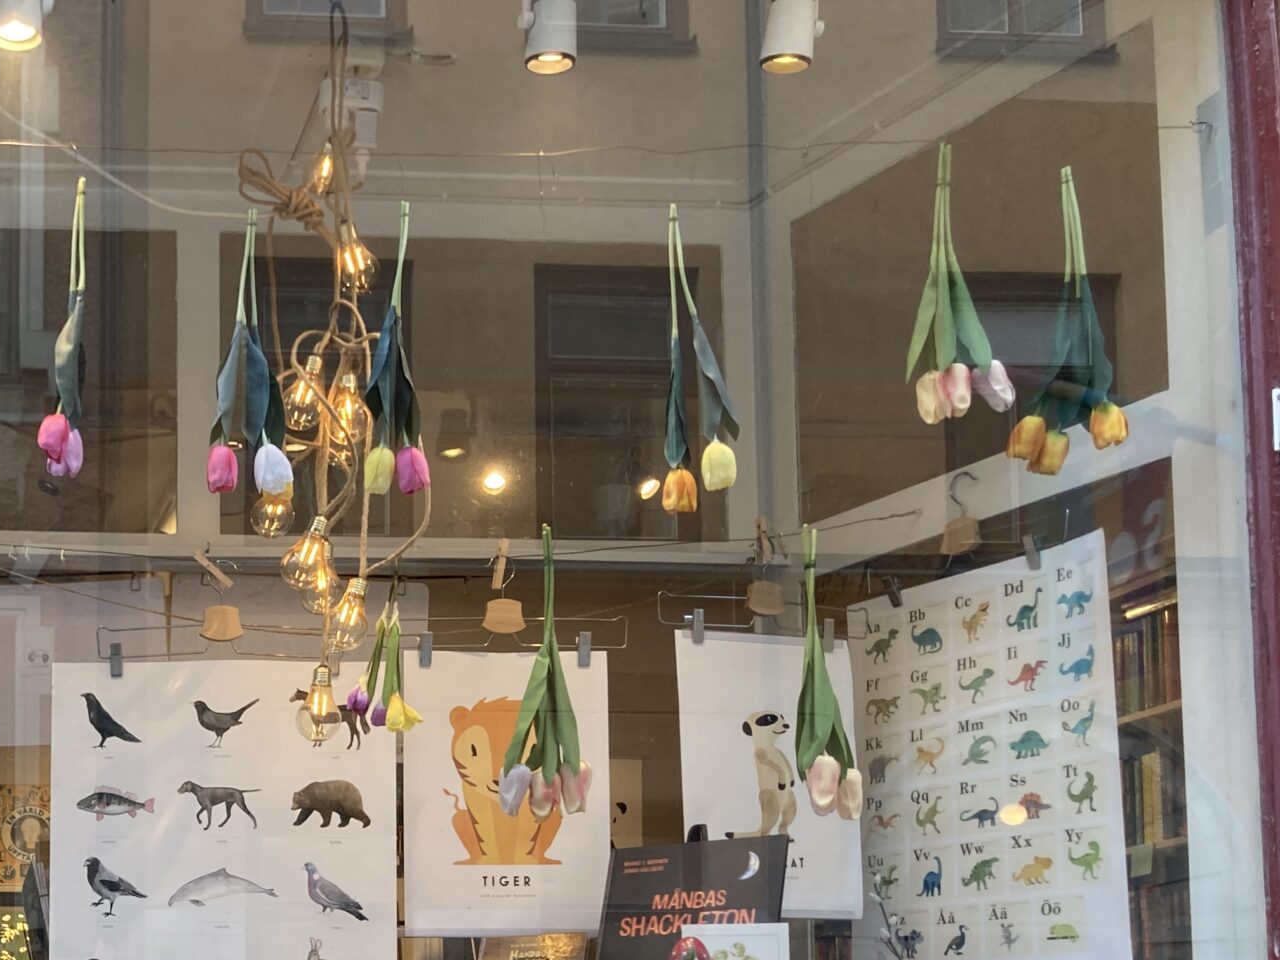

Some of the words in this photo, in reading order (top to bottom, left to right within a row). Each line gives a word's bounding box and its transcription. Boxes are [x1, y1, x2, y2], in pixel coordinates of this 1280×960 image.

[1056, 567, 1074, 583] Ee
[1003, 579, 1024, 598] Dd
[954, 595, 972, 610] Cc
[909, 609, 926, 625] Bb
[1057, 632, 1072, 649] Jj
[1007, 646, 1018, 661] Ii
[957, 656, 977, 672] Hh
[910, 668, 928, 685] Gg
[866, 677, 881, 693] Ff
[1060, 698, 1080, 714] Oo
[1008, 709, 1029, 725] Nn
[957, 719, 985, 734] Mm
[910, 728, 924, 743] Ll
[865, 738, 883, 751] Kk
[1062, 763, 1079, 780] Tt
[959, 780, 977, 796] Rr
[1009, 773, 1027, 788] Ss
[867, 797, 883, 812] Pp
[910, 789, 930, 805] Qq
[1011, 834, 1033, 850] Xx
[1064, 827, 1084, 843] Yy
[914, 848, 931, 862] Vv
[959, 842, 986, 857] Ww
[868, 855, 884, 869] Uu
[482, 874, 532, 888] TIGER
[652, 888, 728, 910] MÅNBAS
[988, 903, 1008, 922] Ää
[1040, 898, 1062, 917] Öö
[936, 908, 957, 926] Åå
